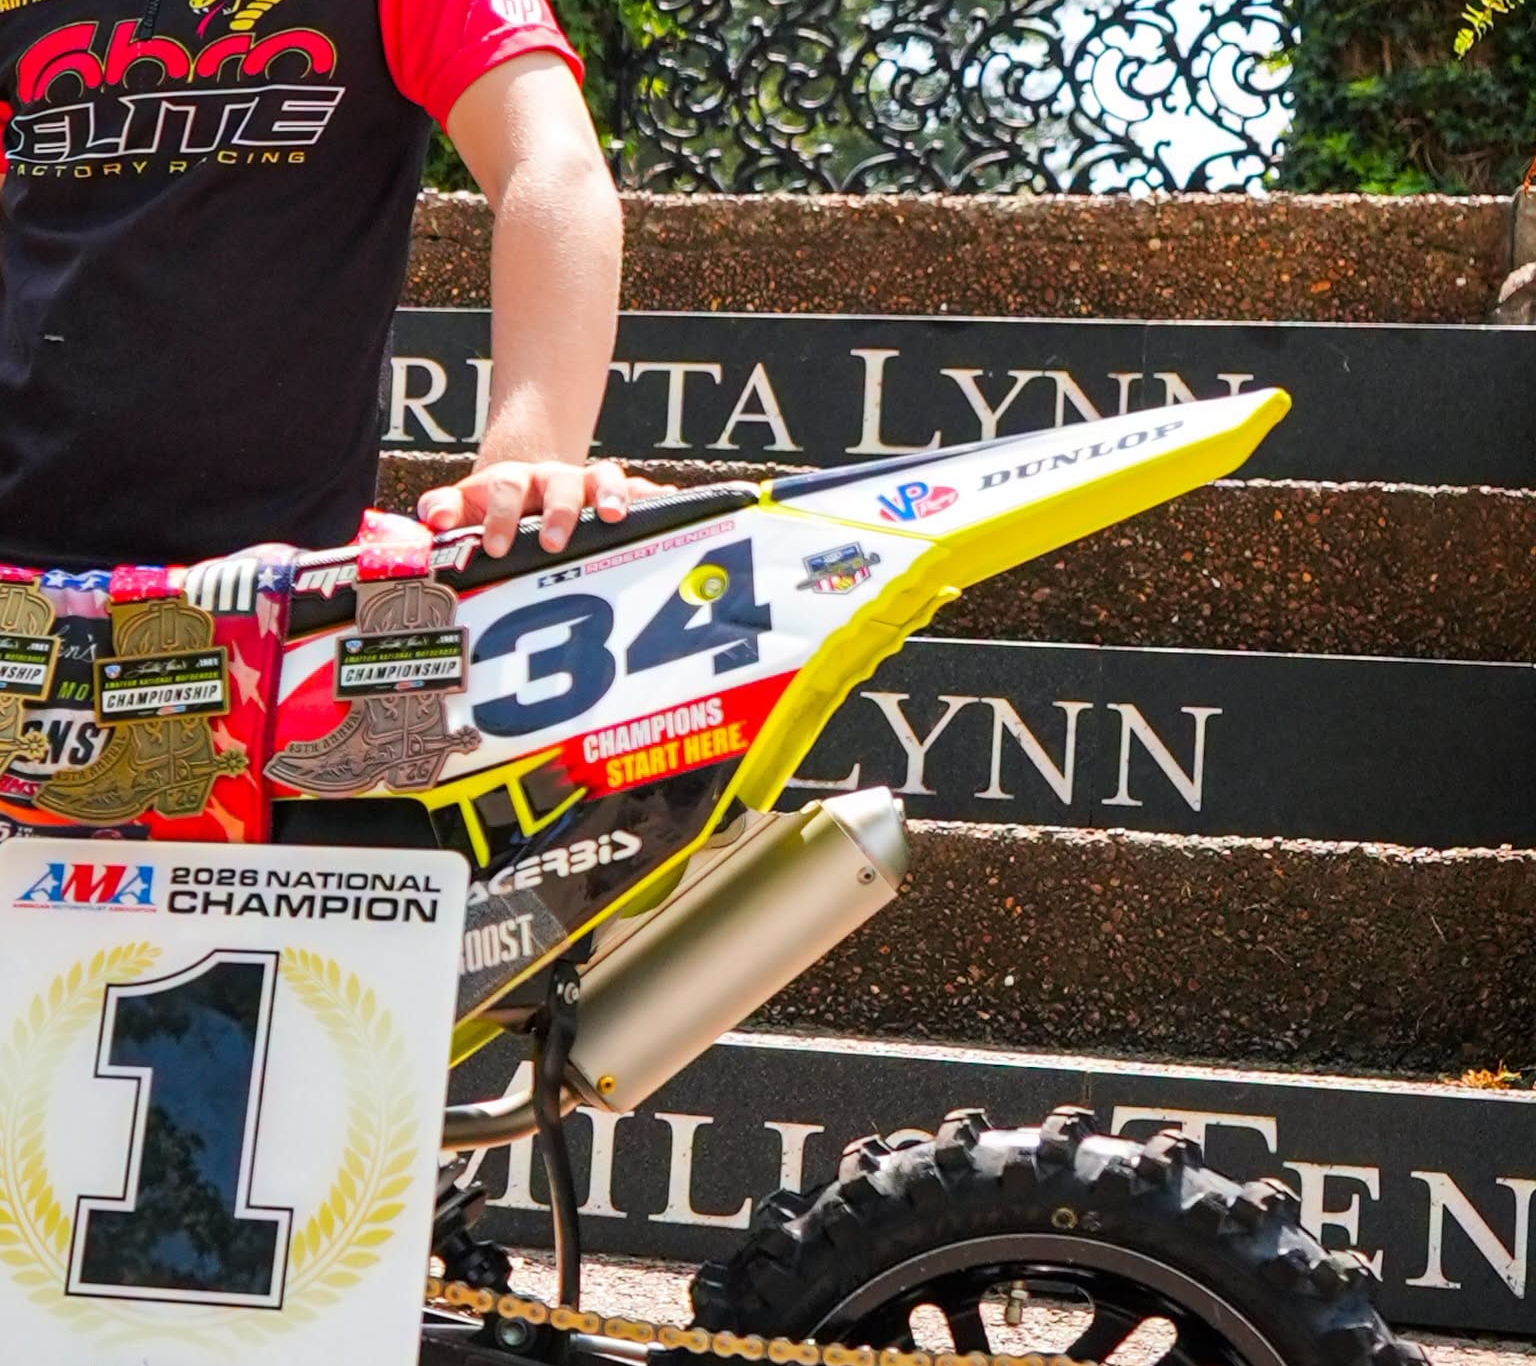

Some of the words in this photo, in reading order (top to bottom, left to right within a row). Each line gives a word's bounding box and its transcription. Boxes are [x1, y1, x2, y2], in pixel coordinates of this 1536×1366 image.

[4, 84, 347, 164] ELITE
[9, 159, 148, 179] ACTORY
[168, 149, 307, 175] RCING
[976, 419, 1186, 492] DUNLOP
[876, 480, 930, 523] VP
[584, 543, 660, 575] ROBERT
[662, 519, 736, 552] FENDER
[469, 536, 773, 739] 34
[106, 684, 218, 709] CHAMPIONSHIP
[345, 660, 457, 683] CHAMPIONSHIP
[582, 696, 725, 765] CHAMPIONS
[605, 740, 681, 789] START
[14, 862, 158, 907] AMA
[169, 865, 260, 887] 2026
[265, 870, 443, 894] NATIONAL
[166, 889, 439, 924] CHAMPION
[458, 913, 535, 974] OOST
[64, 948, 295, 1311] 1
